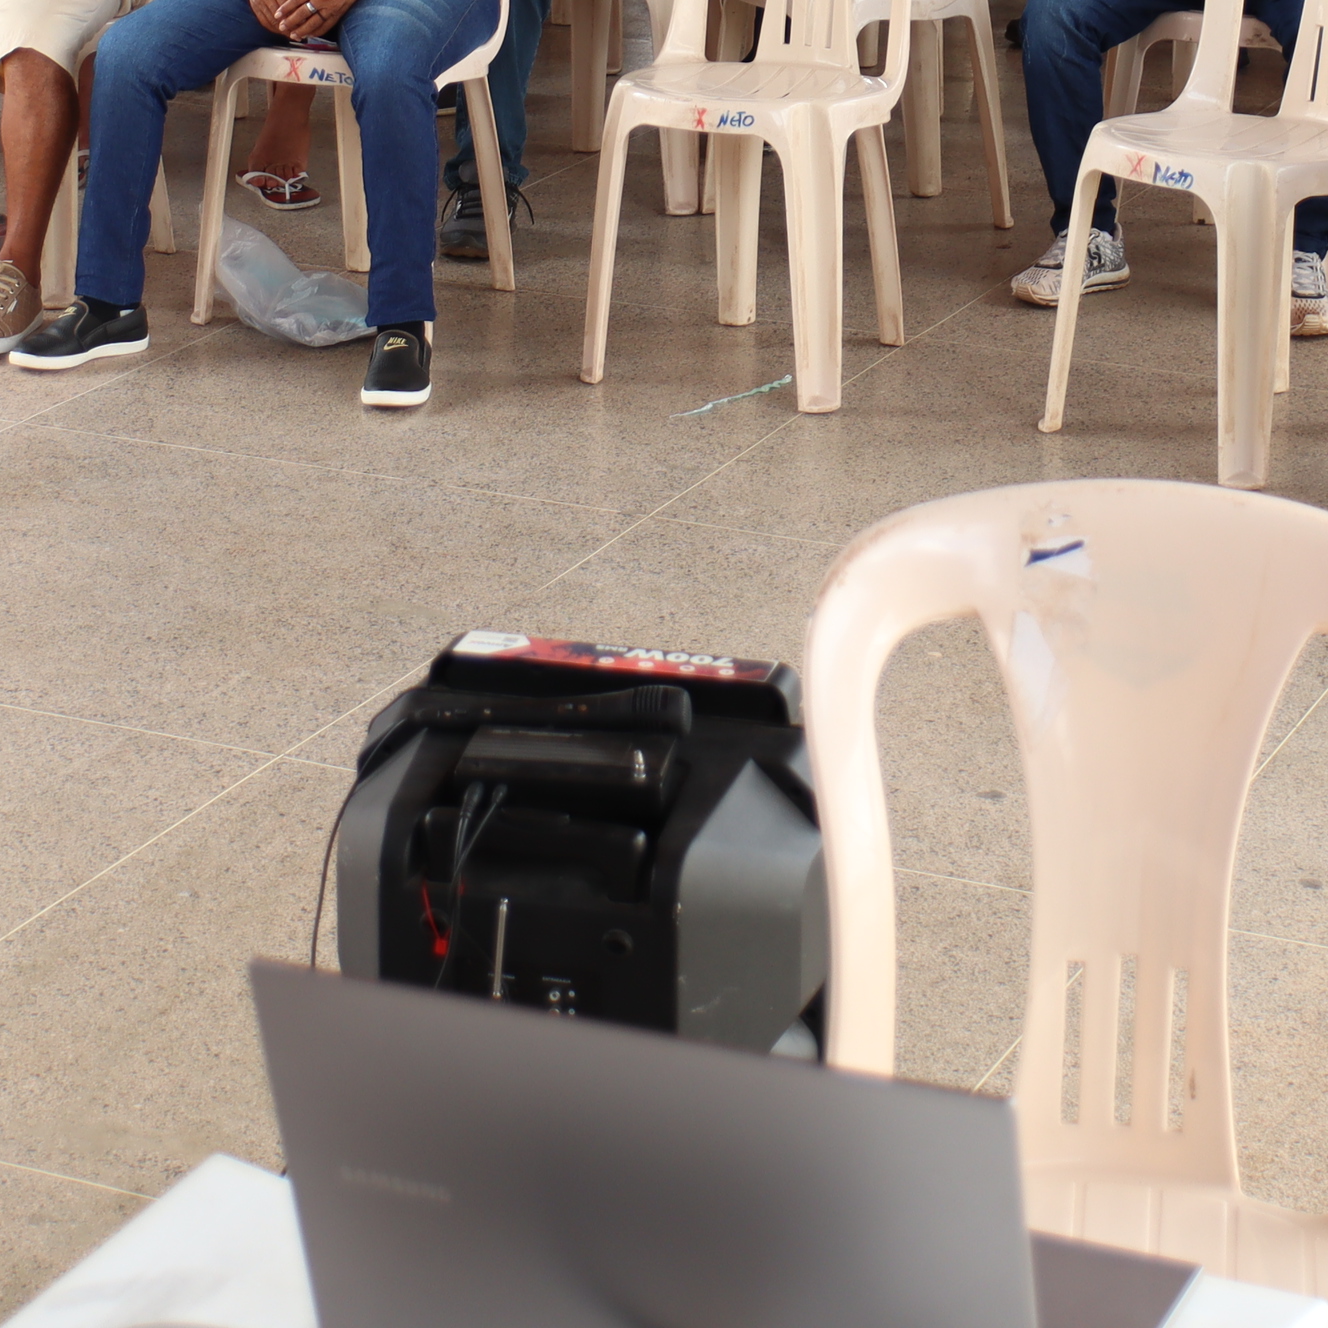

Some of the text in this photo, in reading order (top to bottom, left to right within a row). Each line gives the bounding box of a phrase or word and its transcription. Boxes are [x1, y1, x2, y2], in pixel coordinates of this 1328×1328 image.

[308, 67, 355, 85] NETO
[386, 336, 407, 345] NIKE
[595, 644, 734, 668] 700W RMS
